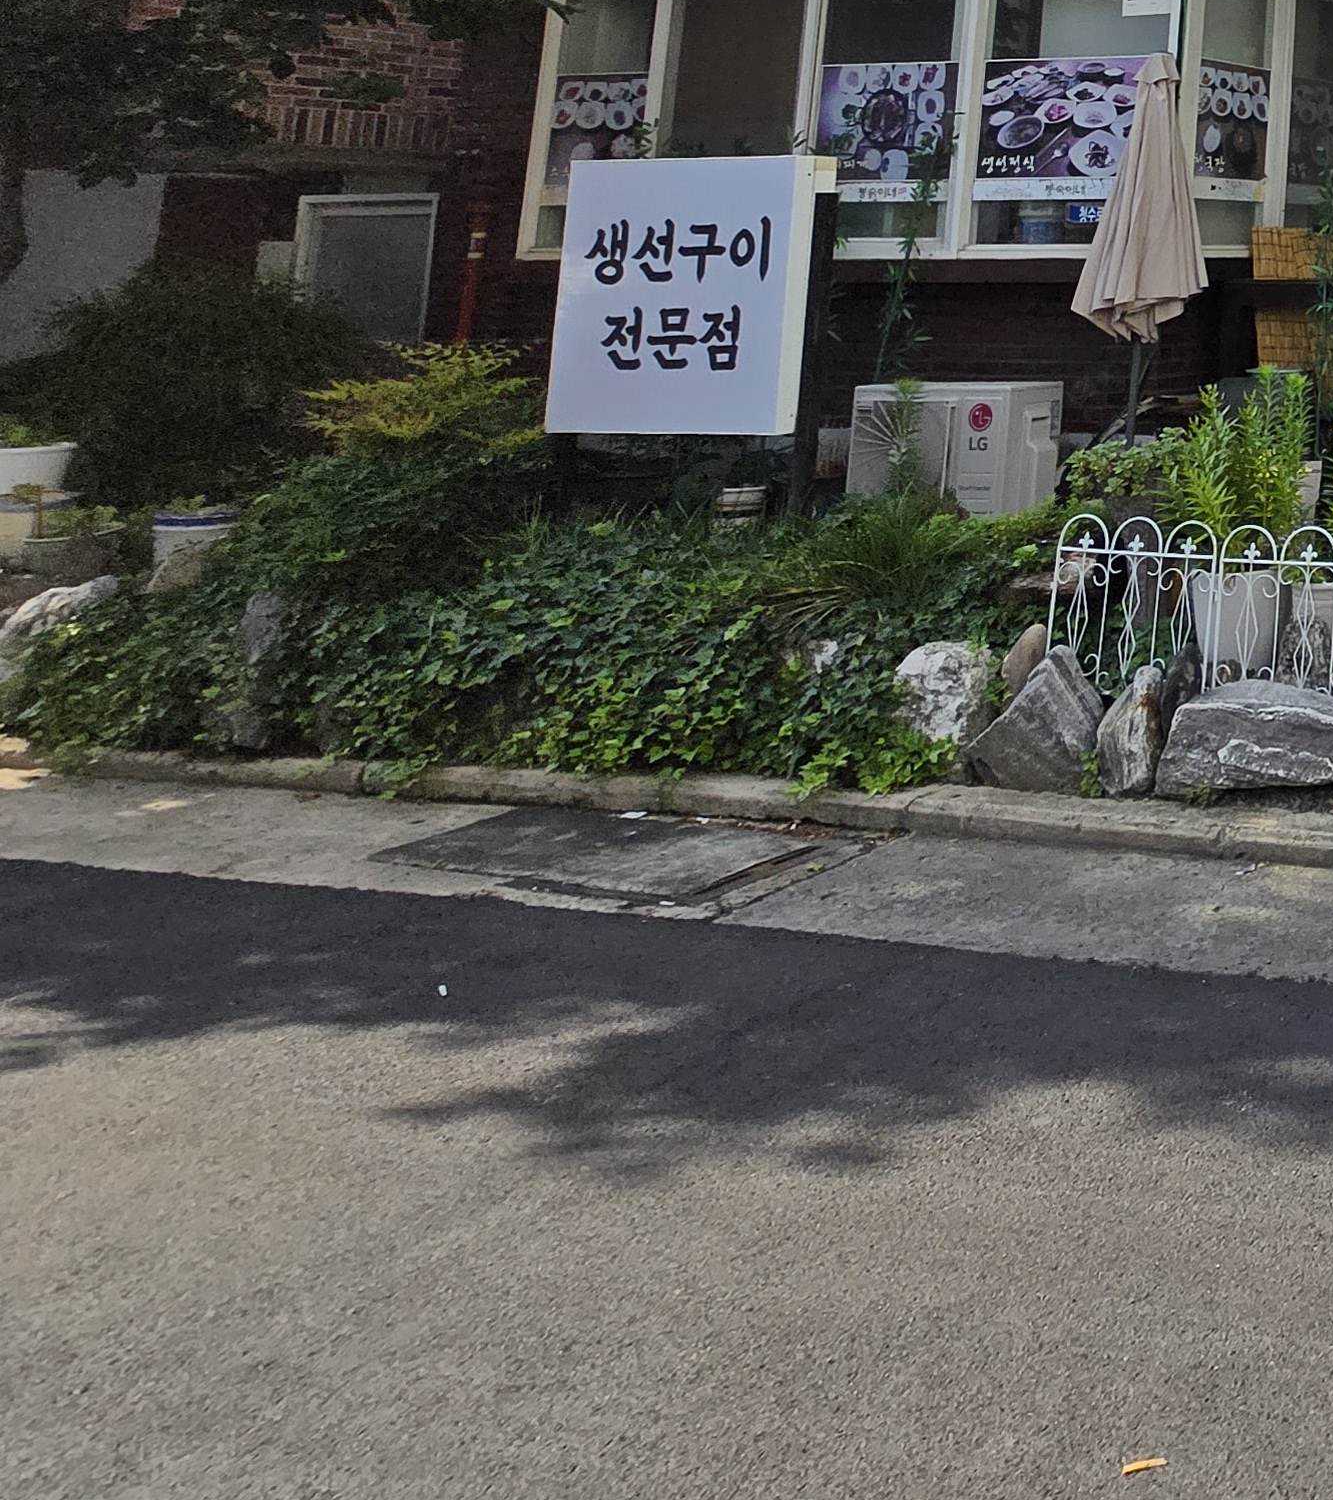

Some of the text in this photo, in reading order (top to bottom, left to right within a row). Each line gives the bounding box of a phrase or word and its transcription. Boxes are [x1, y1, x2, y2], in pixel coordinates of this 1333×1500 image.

[584, 215, 771, 285] 생선구이
[601, 304, 741, 371] 전문점
[969, 436, 988, 451] LG
